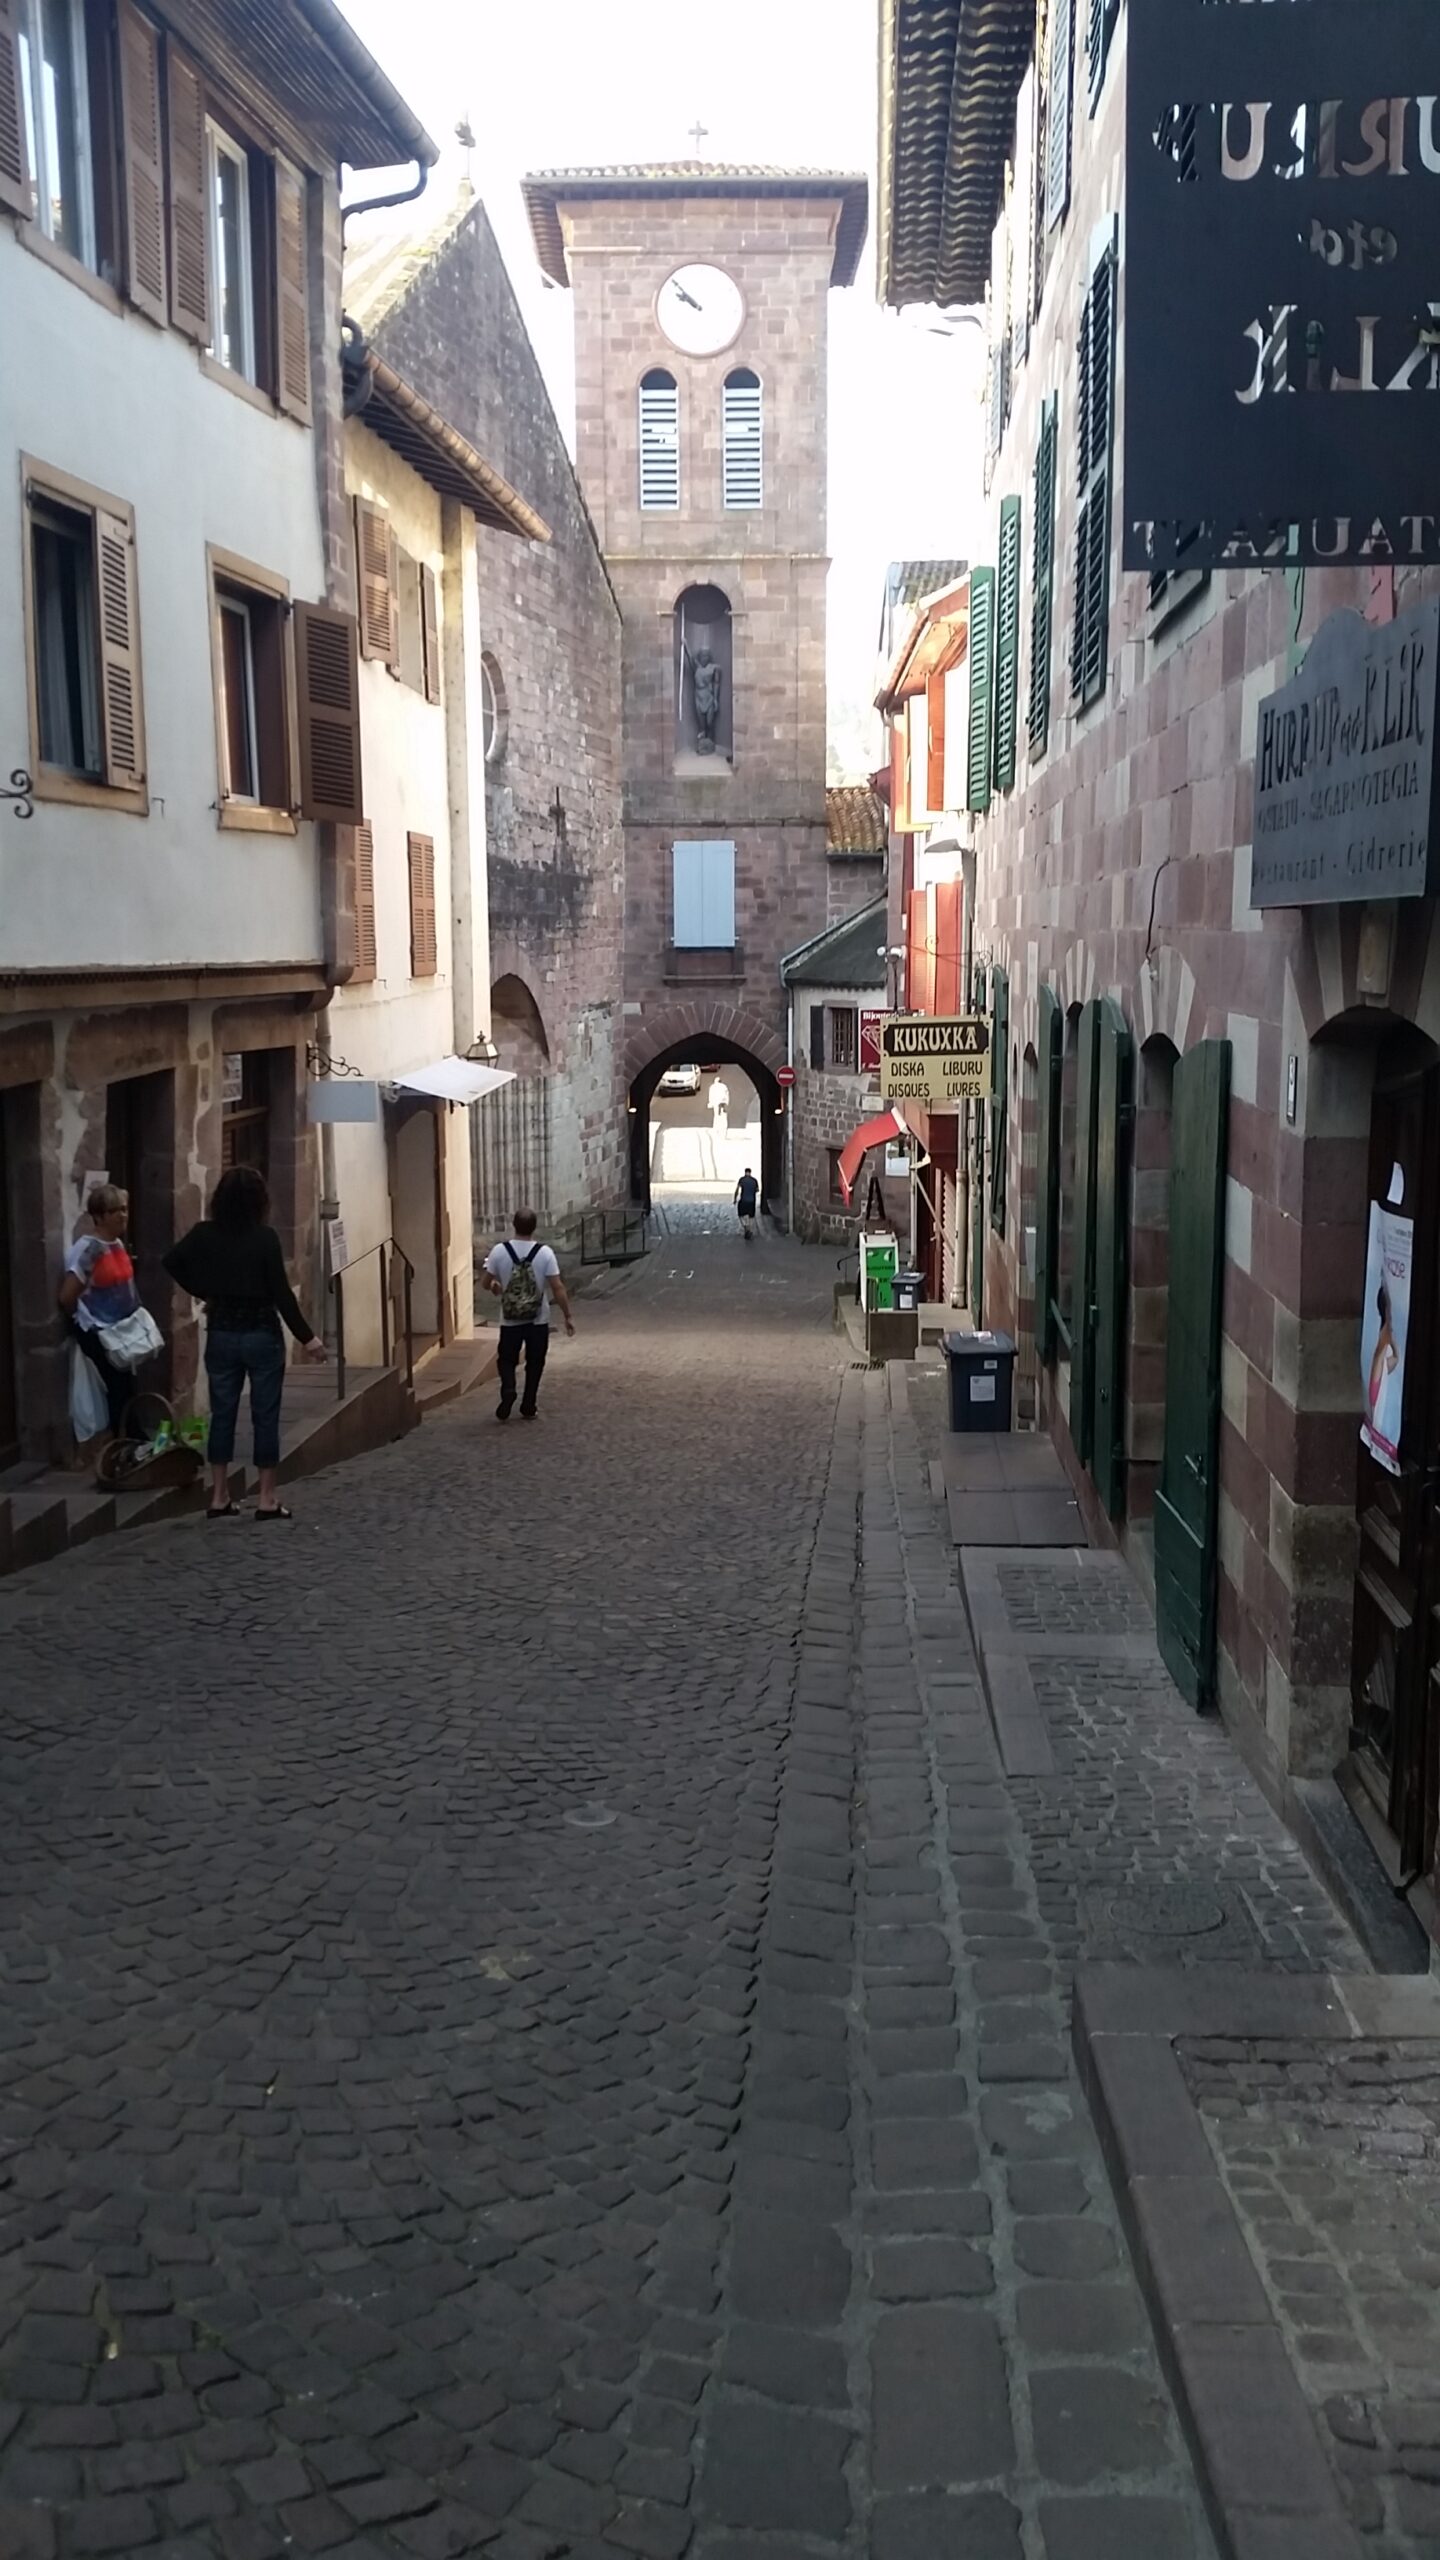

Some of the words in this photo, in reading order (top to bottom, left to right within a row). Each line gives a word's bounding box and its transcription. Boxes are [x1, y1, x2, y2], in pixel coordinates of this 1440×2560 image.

[1347, 830, 1426, 875] Cidrerie
[893, 1026, 978, 1052] KUKUXKA
[891, 1062, 925, 1076] DISKA
[943, 1061, 983, 1076] LIBURU
[888, 1083, 930, 1098] DISQUES
[947, 1082, 981, 1097] LIVRES
